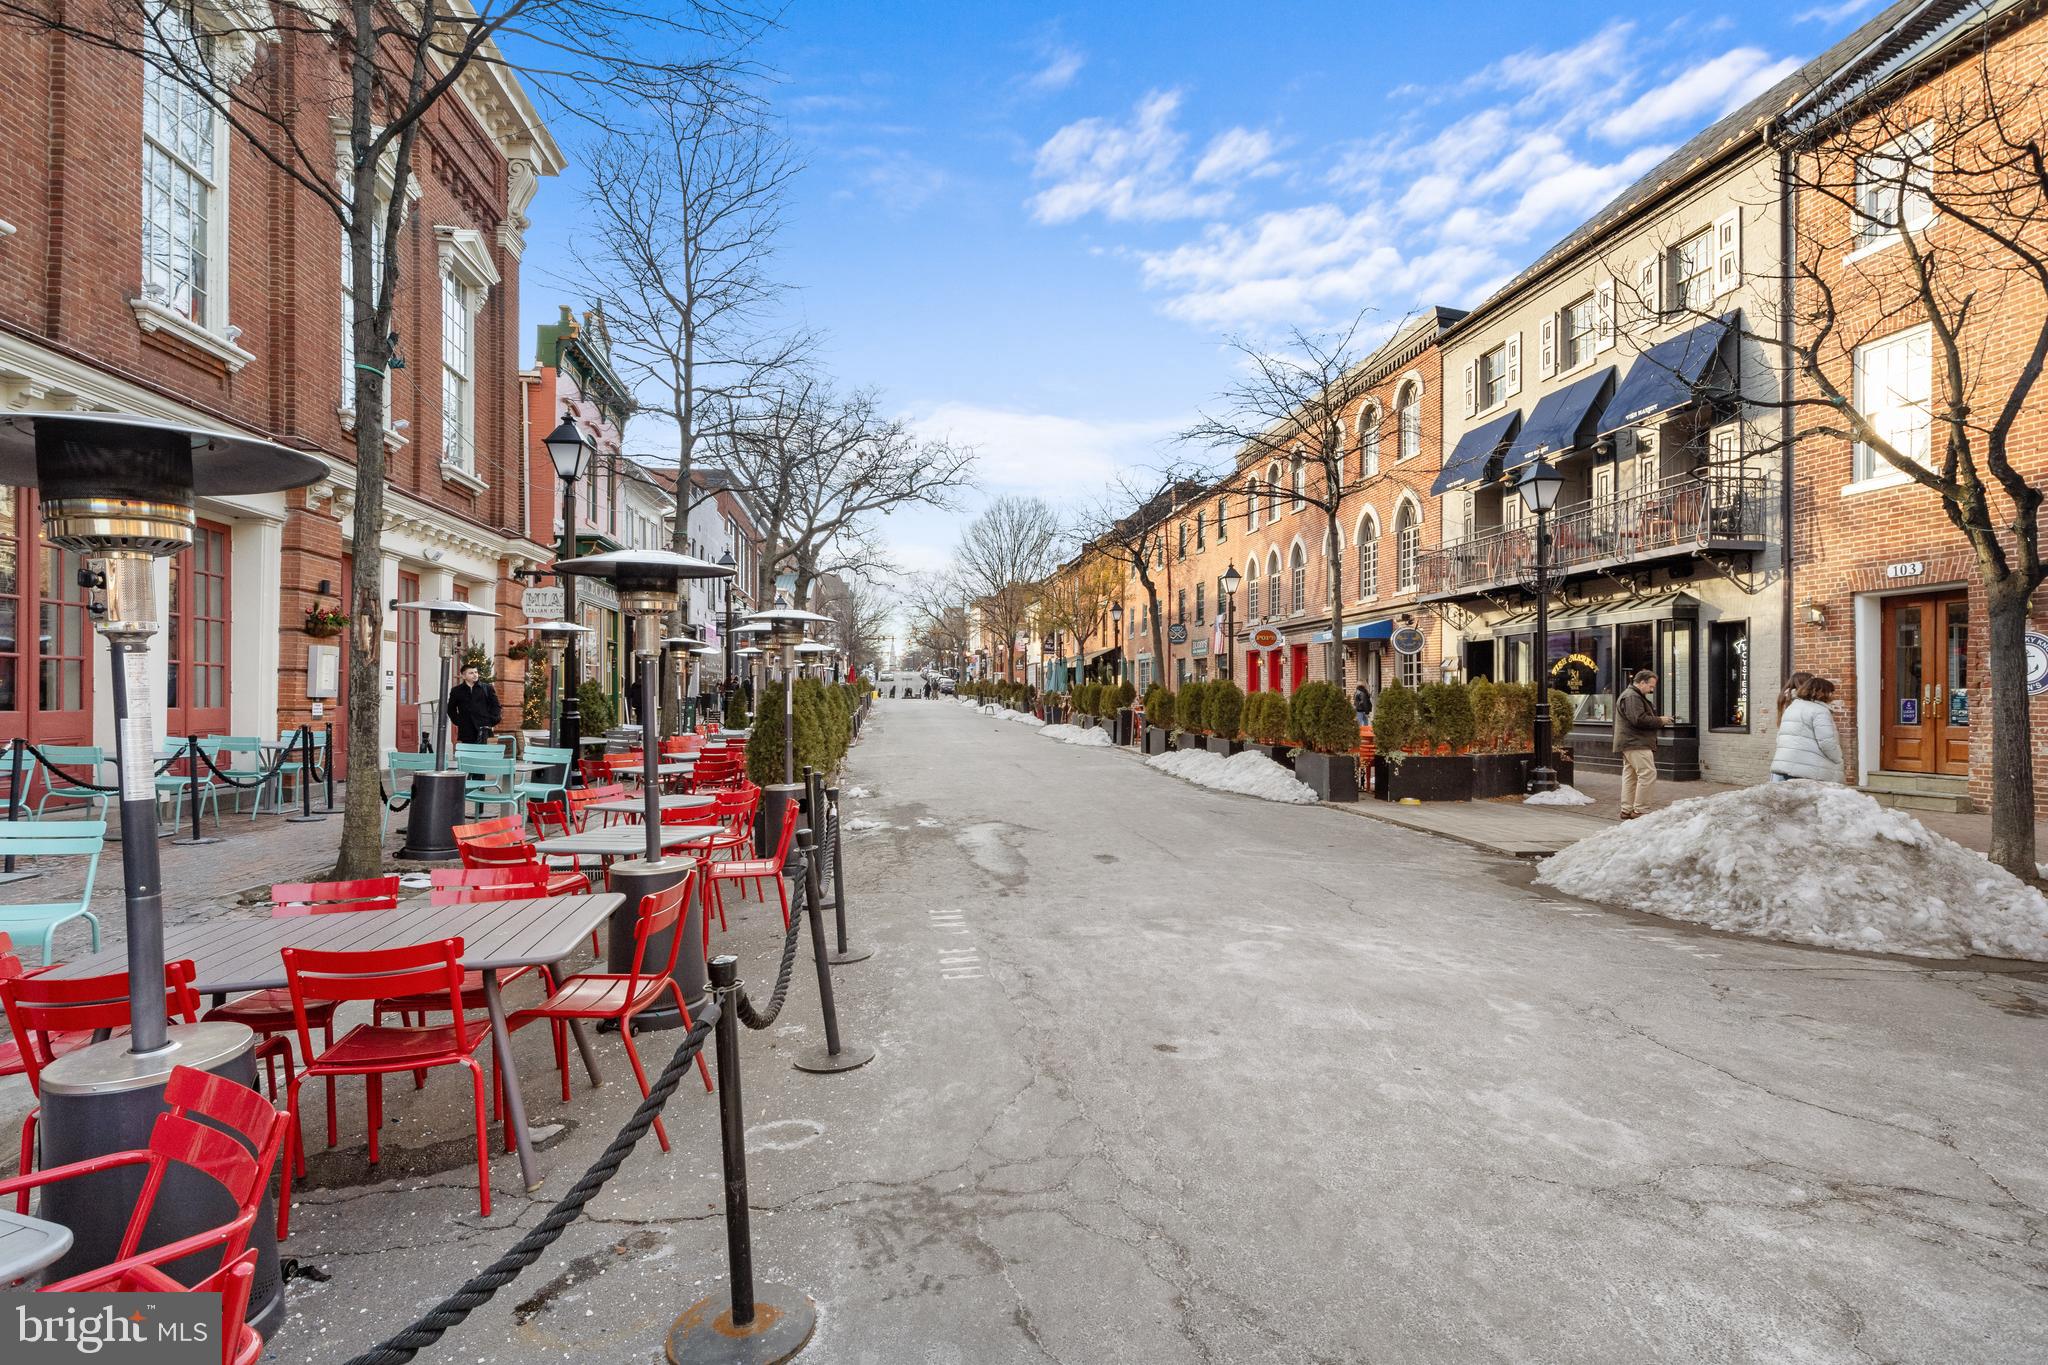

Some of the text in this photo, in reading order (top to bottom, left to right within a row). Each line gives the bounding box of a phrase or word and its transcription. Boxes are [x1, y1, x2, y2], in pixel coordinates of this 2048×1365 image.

[1893, 563, 1916, 576] 103
[526, 592, 564, 607] MIA'
[2036, 639, 2048, 652] KNO
[2027, 682, 2042, 690] N'S
